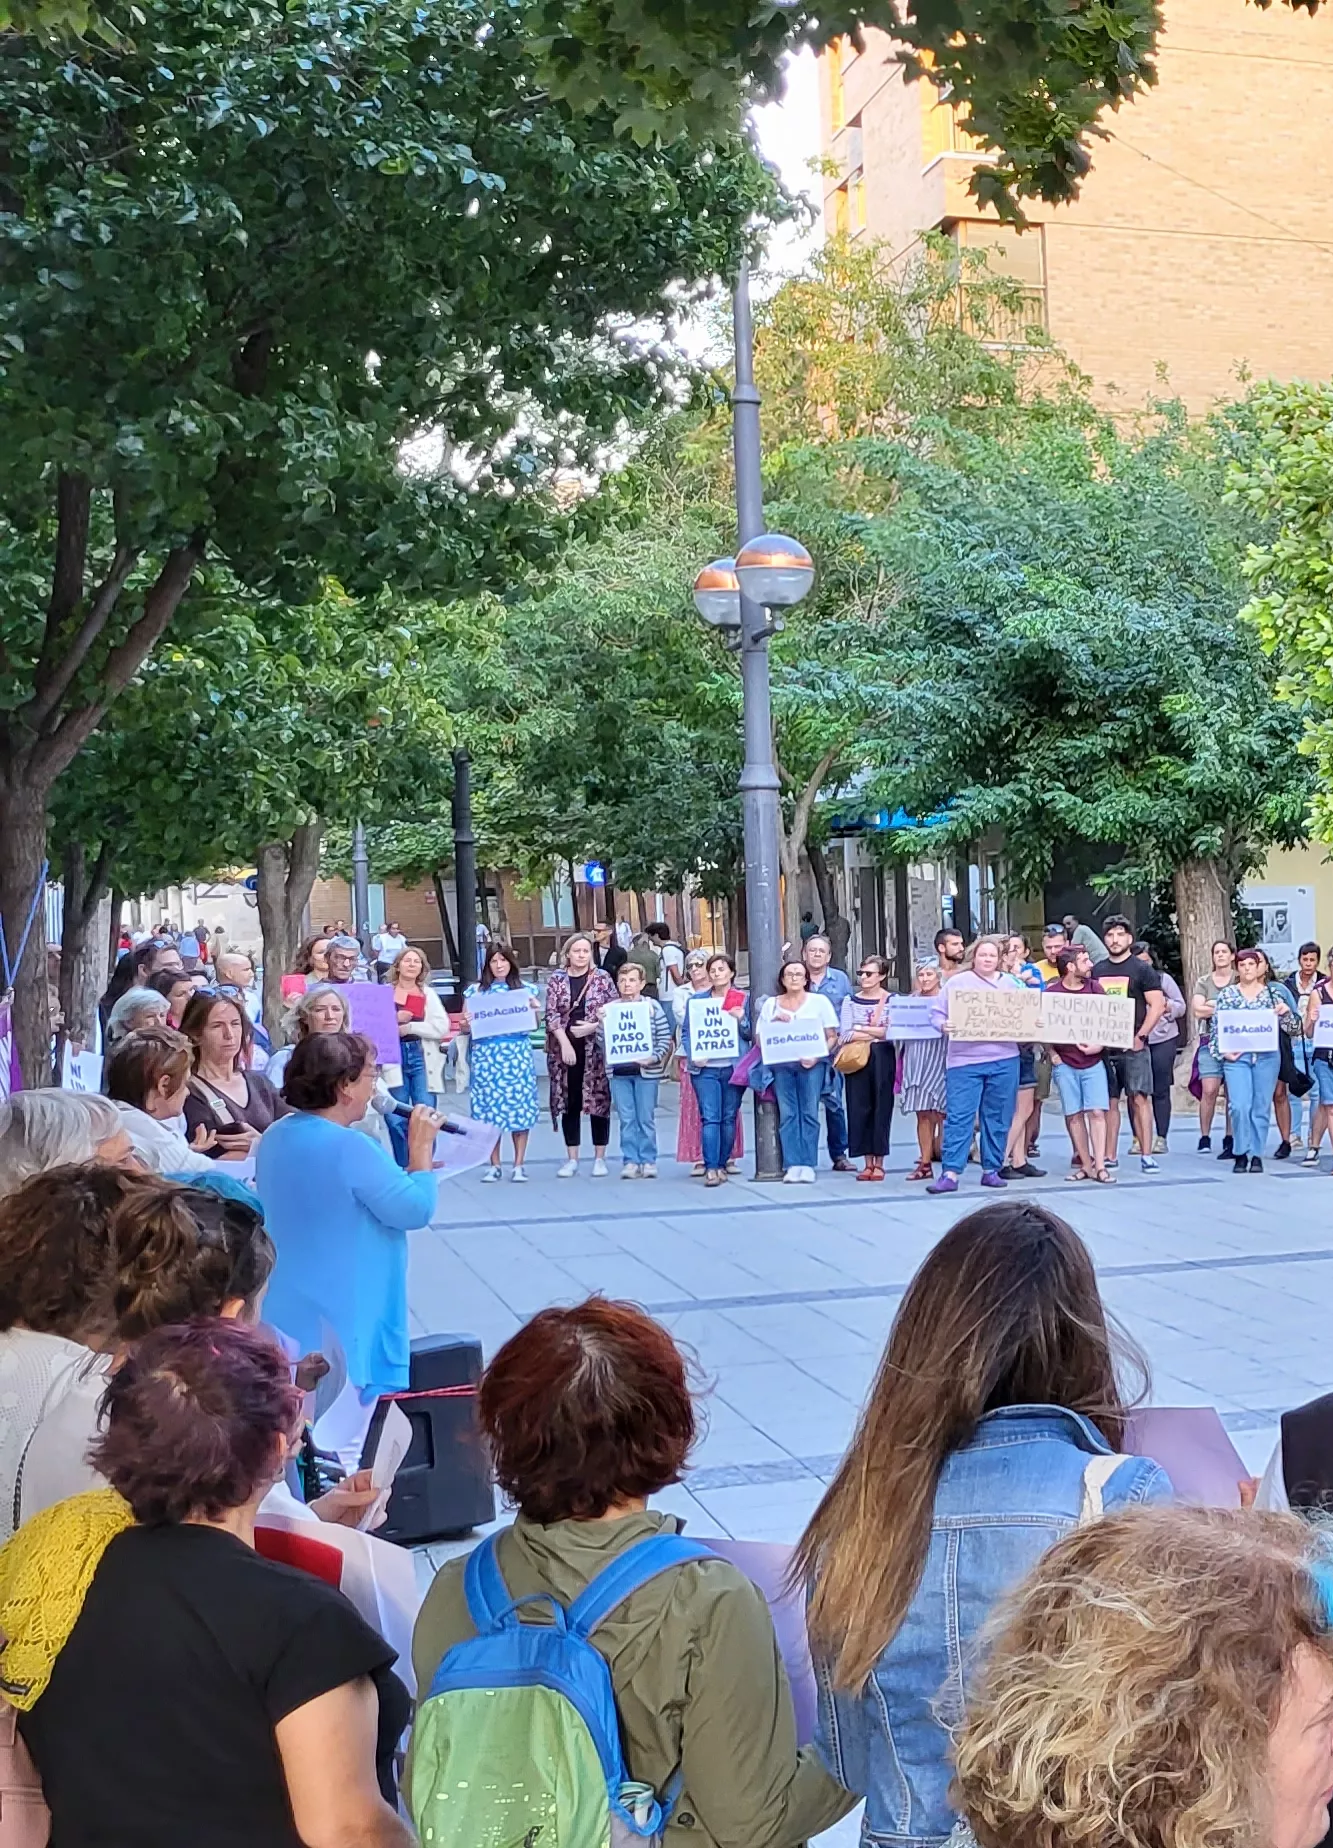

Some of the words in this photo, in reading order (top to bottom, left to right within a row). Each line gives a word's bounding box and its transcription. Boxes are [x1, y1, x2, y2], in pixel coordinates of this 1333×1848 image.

[955, 990, 981, 1003] POR
[985, 991, 998, 1003] EL
[473, 1005, 529, 1020] #SeAcabó
[620, 1010, 634, 1021] NI
[706, 1006, 720, 1016] NI
[618, 1022, 637, 1032] UN
[704, 1017, 723, 1027] UN
[964, 1018, 1024, 1031] FEMINISMO
[697, 1028, 731, 1039] PASO
[1223, 1023, 1273, 1034] #SeAcabó
[612, 1033, 645, 1043] PASO
[766, 1033, 820, 1046] #SeAcabó
[610, 1043, 650, 1056] ATRÁS
[694, 1039, 735, 1052] ATRÁS
[69, 1062, 82, 1078] NI
